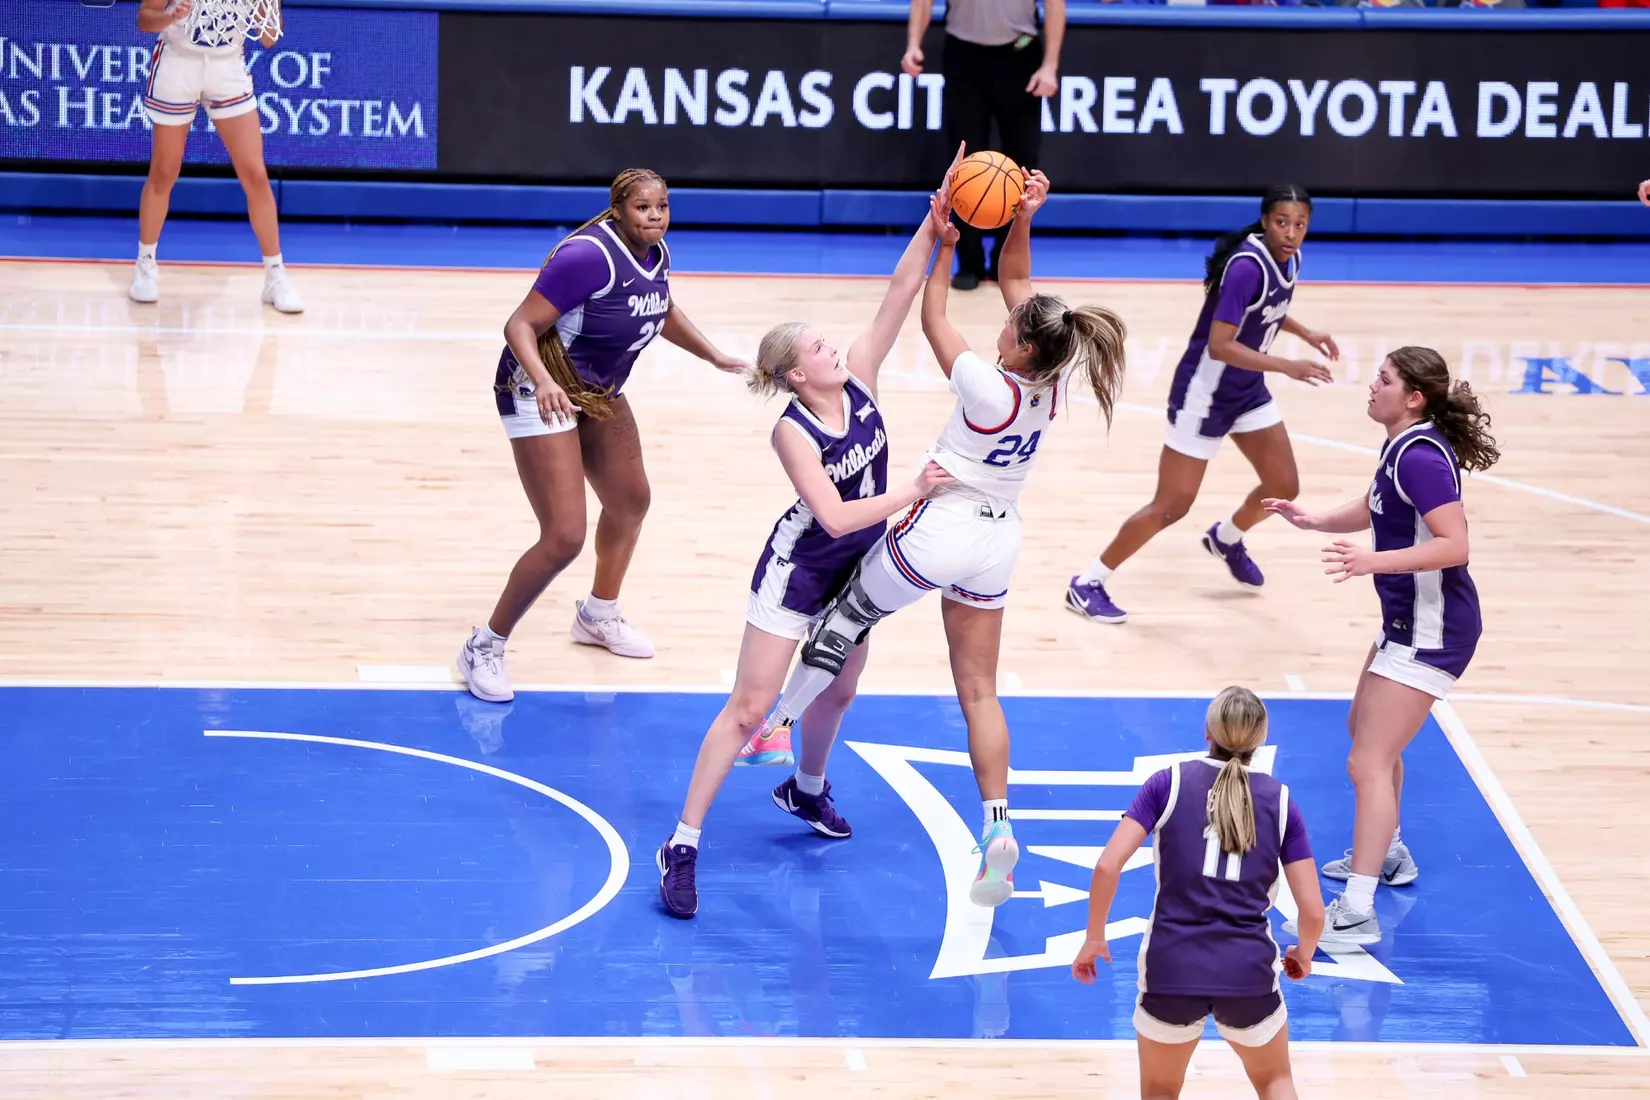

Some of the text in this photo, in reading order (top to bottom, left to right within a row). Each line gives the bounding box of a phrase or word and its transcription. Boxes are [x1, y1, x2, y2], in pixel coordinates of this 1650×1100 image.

[270, 51, 331, 88] OF
[258, 92, 427, 138] SYSTEM
[570, 66, 834, 127] KANSAS
[853, 71, 945, 130] CIT
[1201, 78, 1458, 138] TOYOTA
[1477, 81, 1650, 138] DEAL
[825, 426, 885, 483] Wildcats
[983, 430, 1041, 467] 24
[859, 463, 876, 498] 4
[1203, 824, 1243, 881] 11
